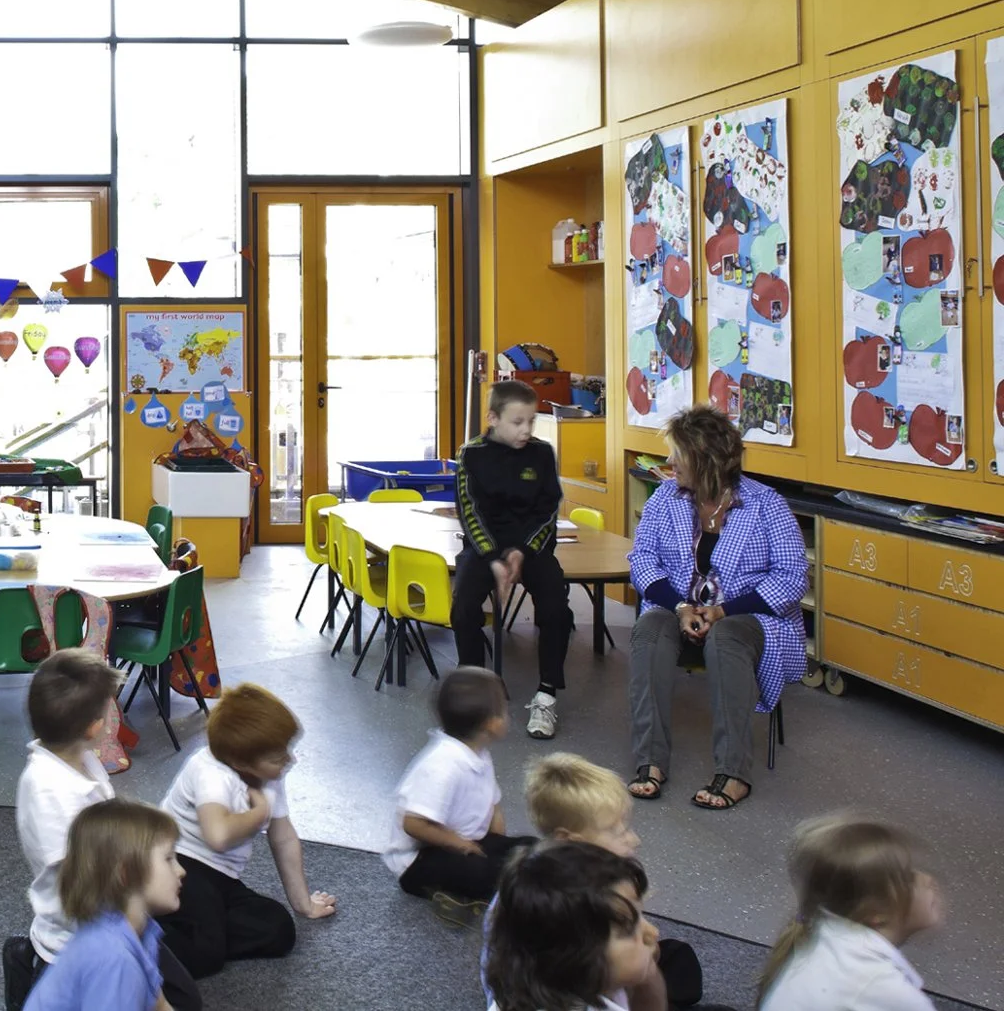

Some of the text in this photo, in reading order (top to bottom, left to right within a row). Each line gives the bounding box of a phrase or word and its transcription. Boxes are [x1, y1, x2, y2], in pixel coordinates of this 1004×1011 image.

[24, 328, 47, 339] Friday
[161, 312, 178, 320] first
[848, 538, 878, 572] A3
[938, 560, 974, 597] A3
[892, 600, 921, 636] A1
[892, 651, 921, 688] A1
